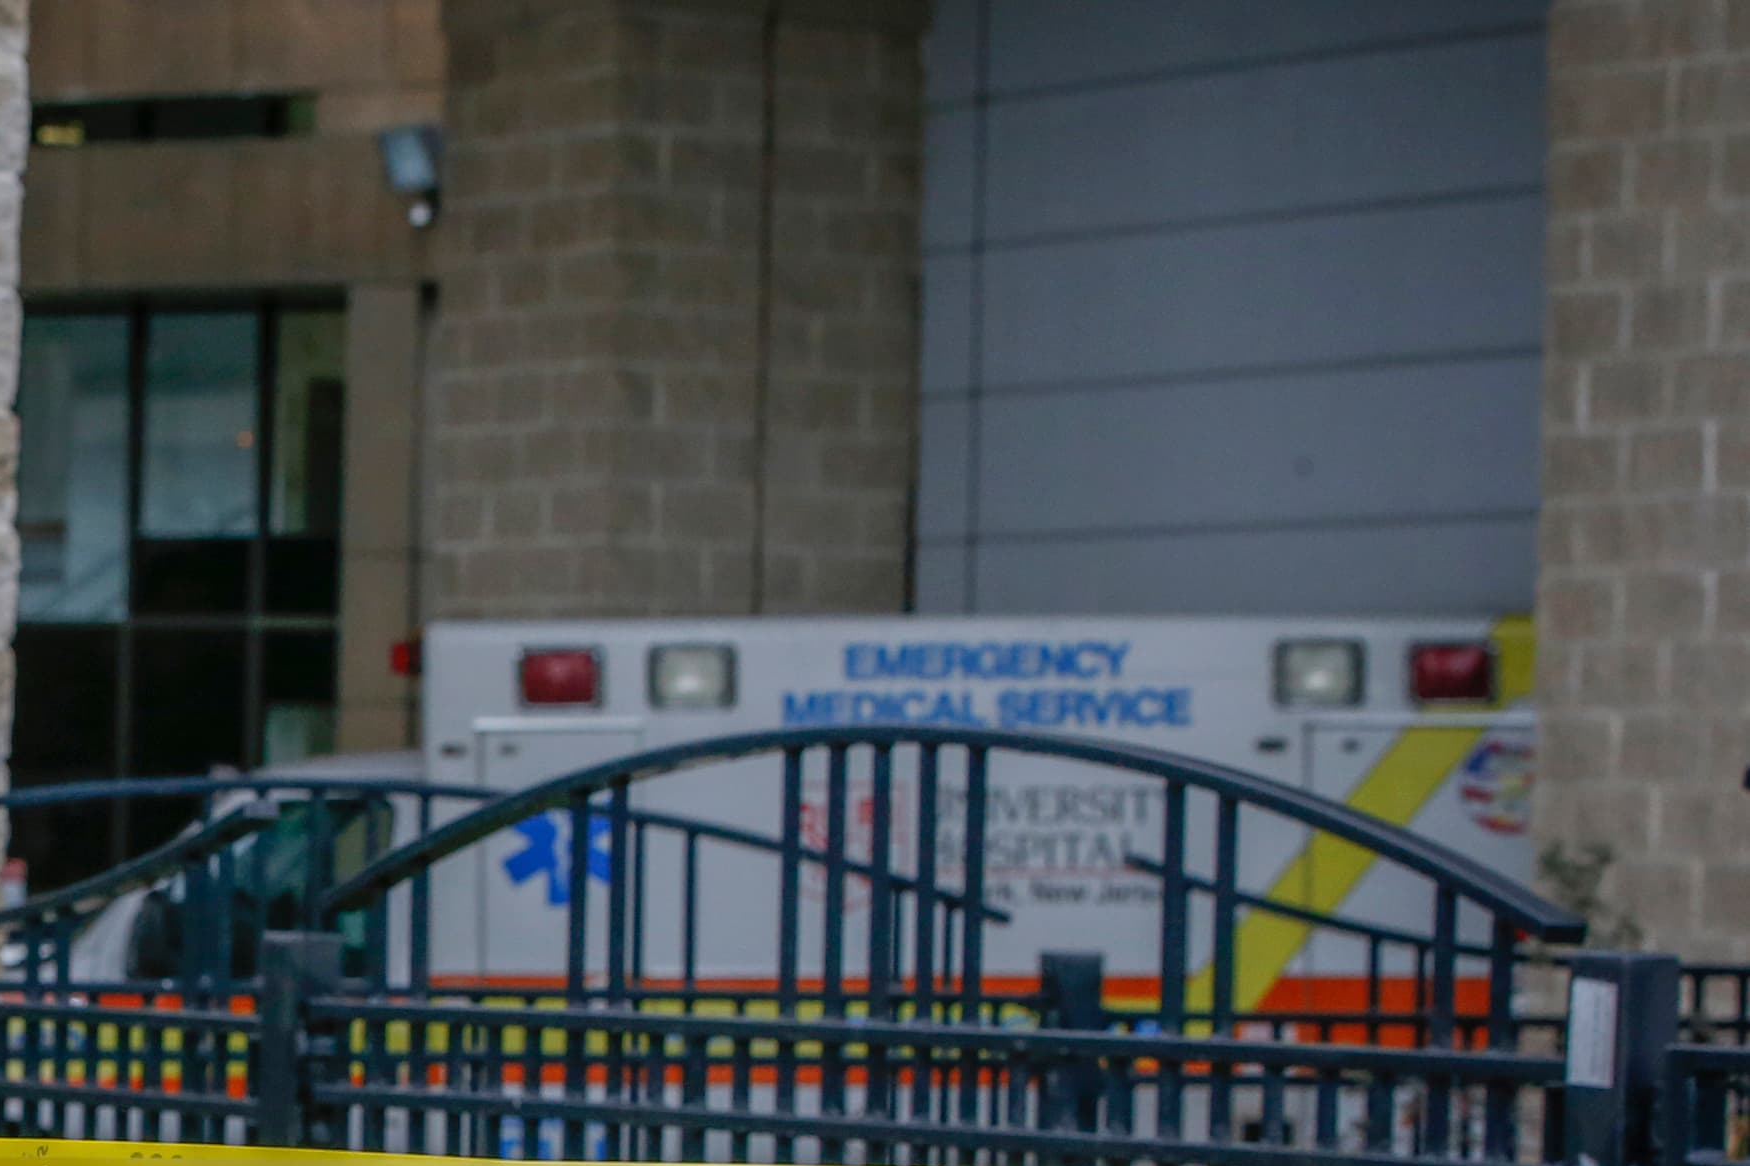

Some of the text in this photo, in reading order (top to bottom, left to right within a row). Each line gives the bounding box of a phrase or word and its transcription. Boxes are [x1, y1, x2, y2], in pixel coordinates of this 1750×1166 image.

[844, 643, 1130, 681] EMERGENCY
[782, 688, 1191, 728] MEDICAL SERVICE
